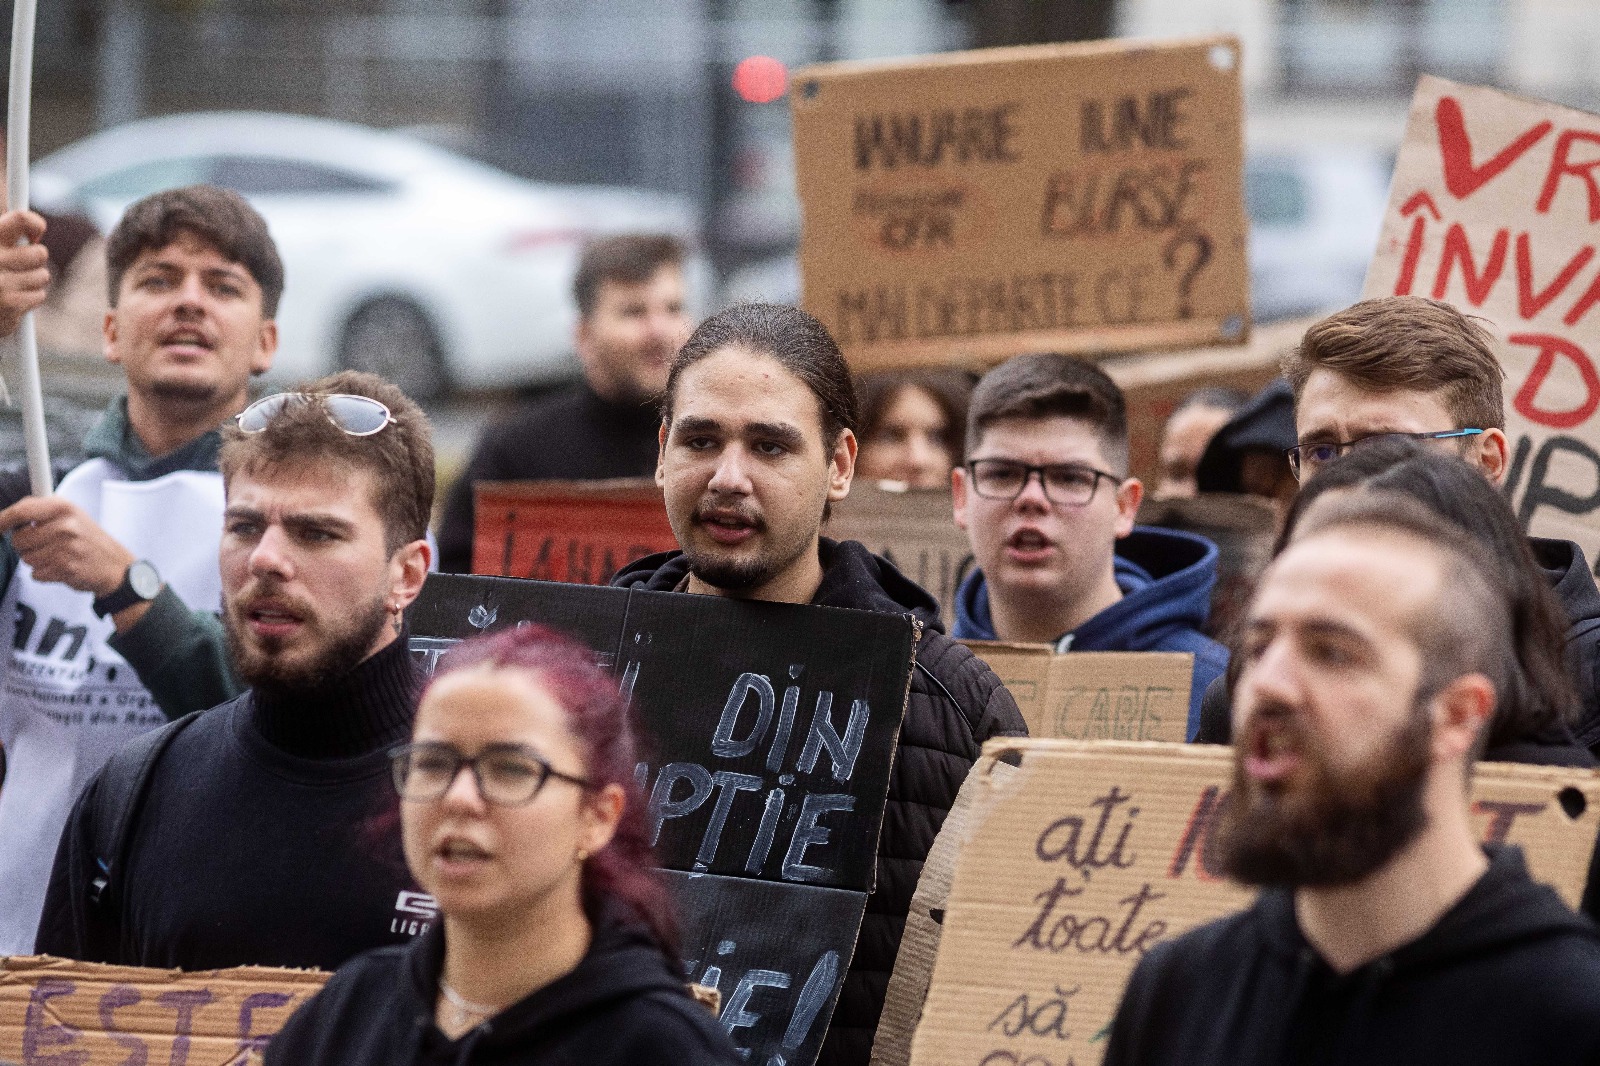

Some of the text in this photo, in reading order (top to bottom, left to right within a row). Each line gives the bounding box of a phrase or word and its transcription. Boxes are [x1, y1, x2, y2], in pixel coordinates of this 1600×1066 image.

[1040, 158, 1210, 240] BURSE
[912, 270, 1078, 336] DEPARTE
[1036, 786, 1140, 881] ați
[1012, 877, 1167, 952] toate
[987, 984, 1081, 1040] să
